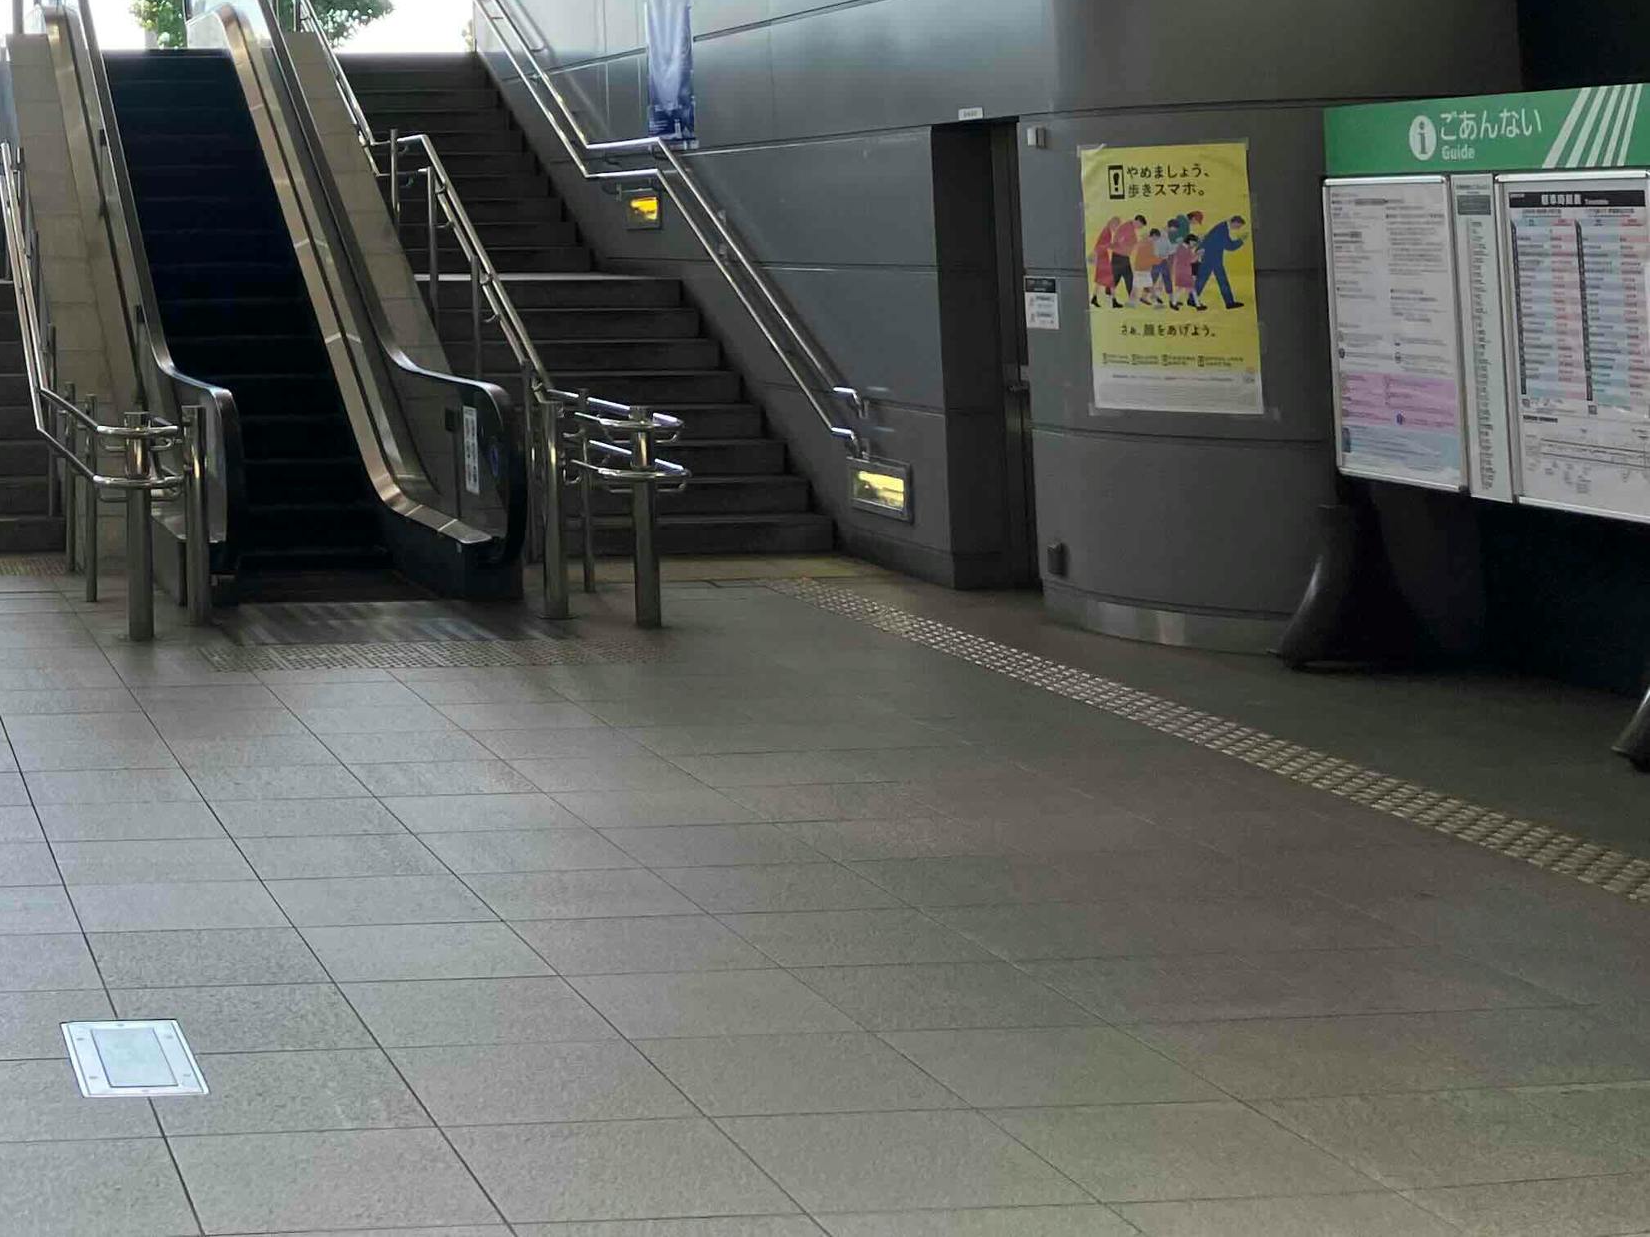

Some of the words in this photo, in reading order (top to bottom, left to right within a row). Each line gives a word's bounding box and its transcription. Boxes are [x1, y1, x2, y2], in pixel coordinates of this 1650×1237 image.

[1440, 107, 1542, 140] ごあんない
[1441, 144, 1475, 160] Guide
[1126, 163, 1210, 179] やめましょう、
[1128, 183, 1206, 198] 歩きスマホ。
